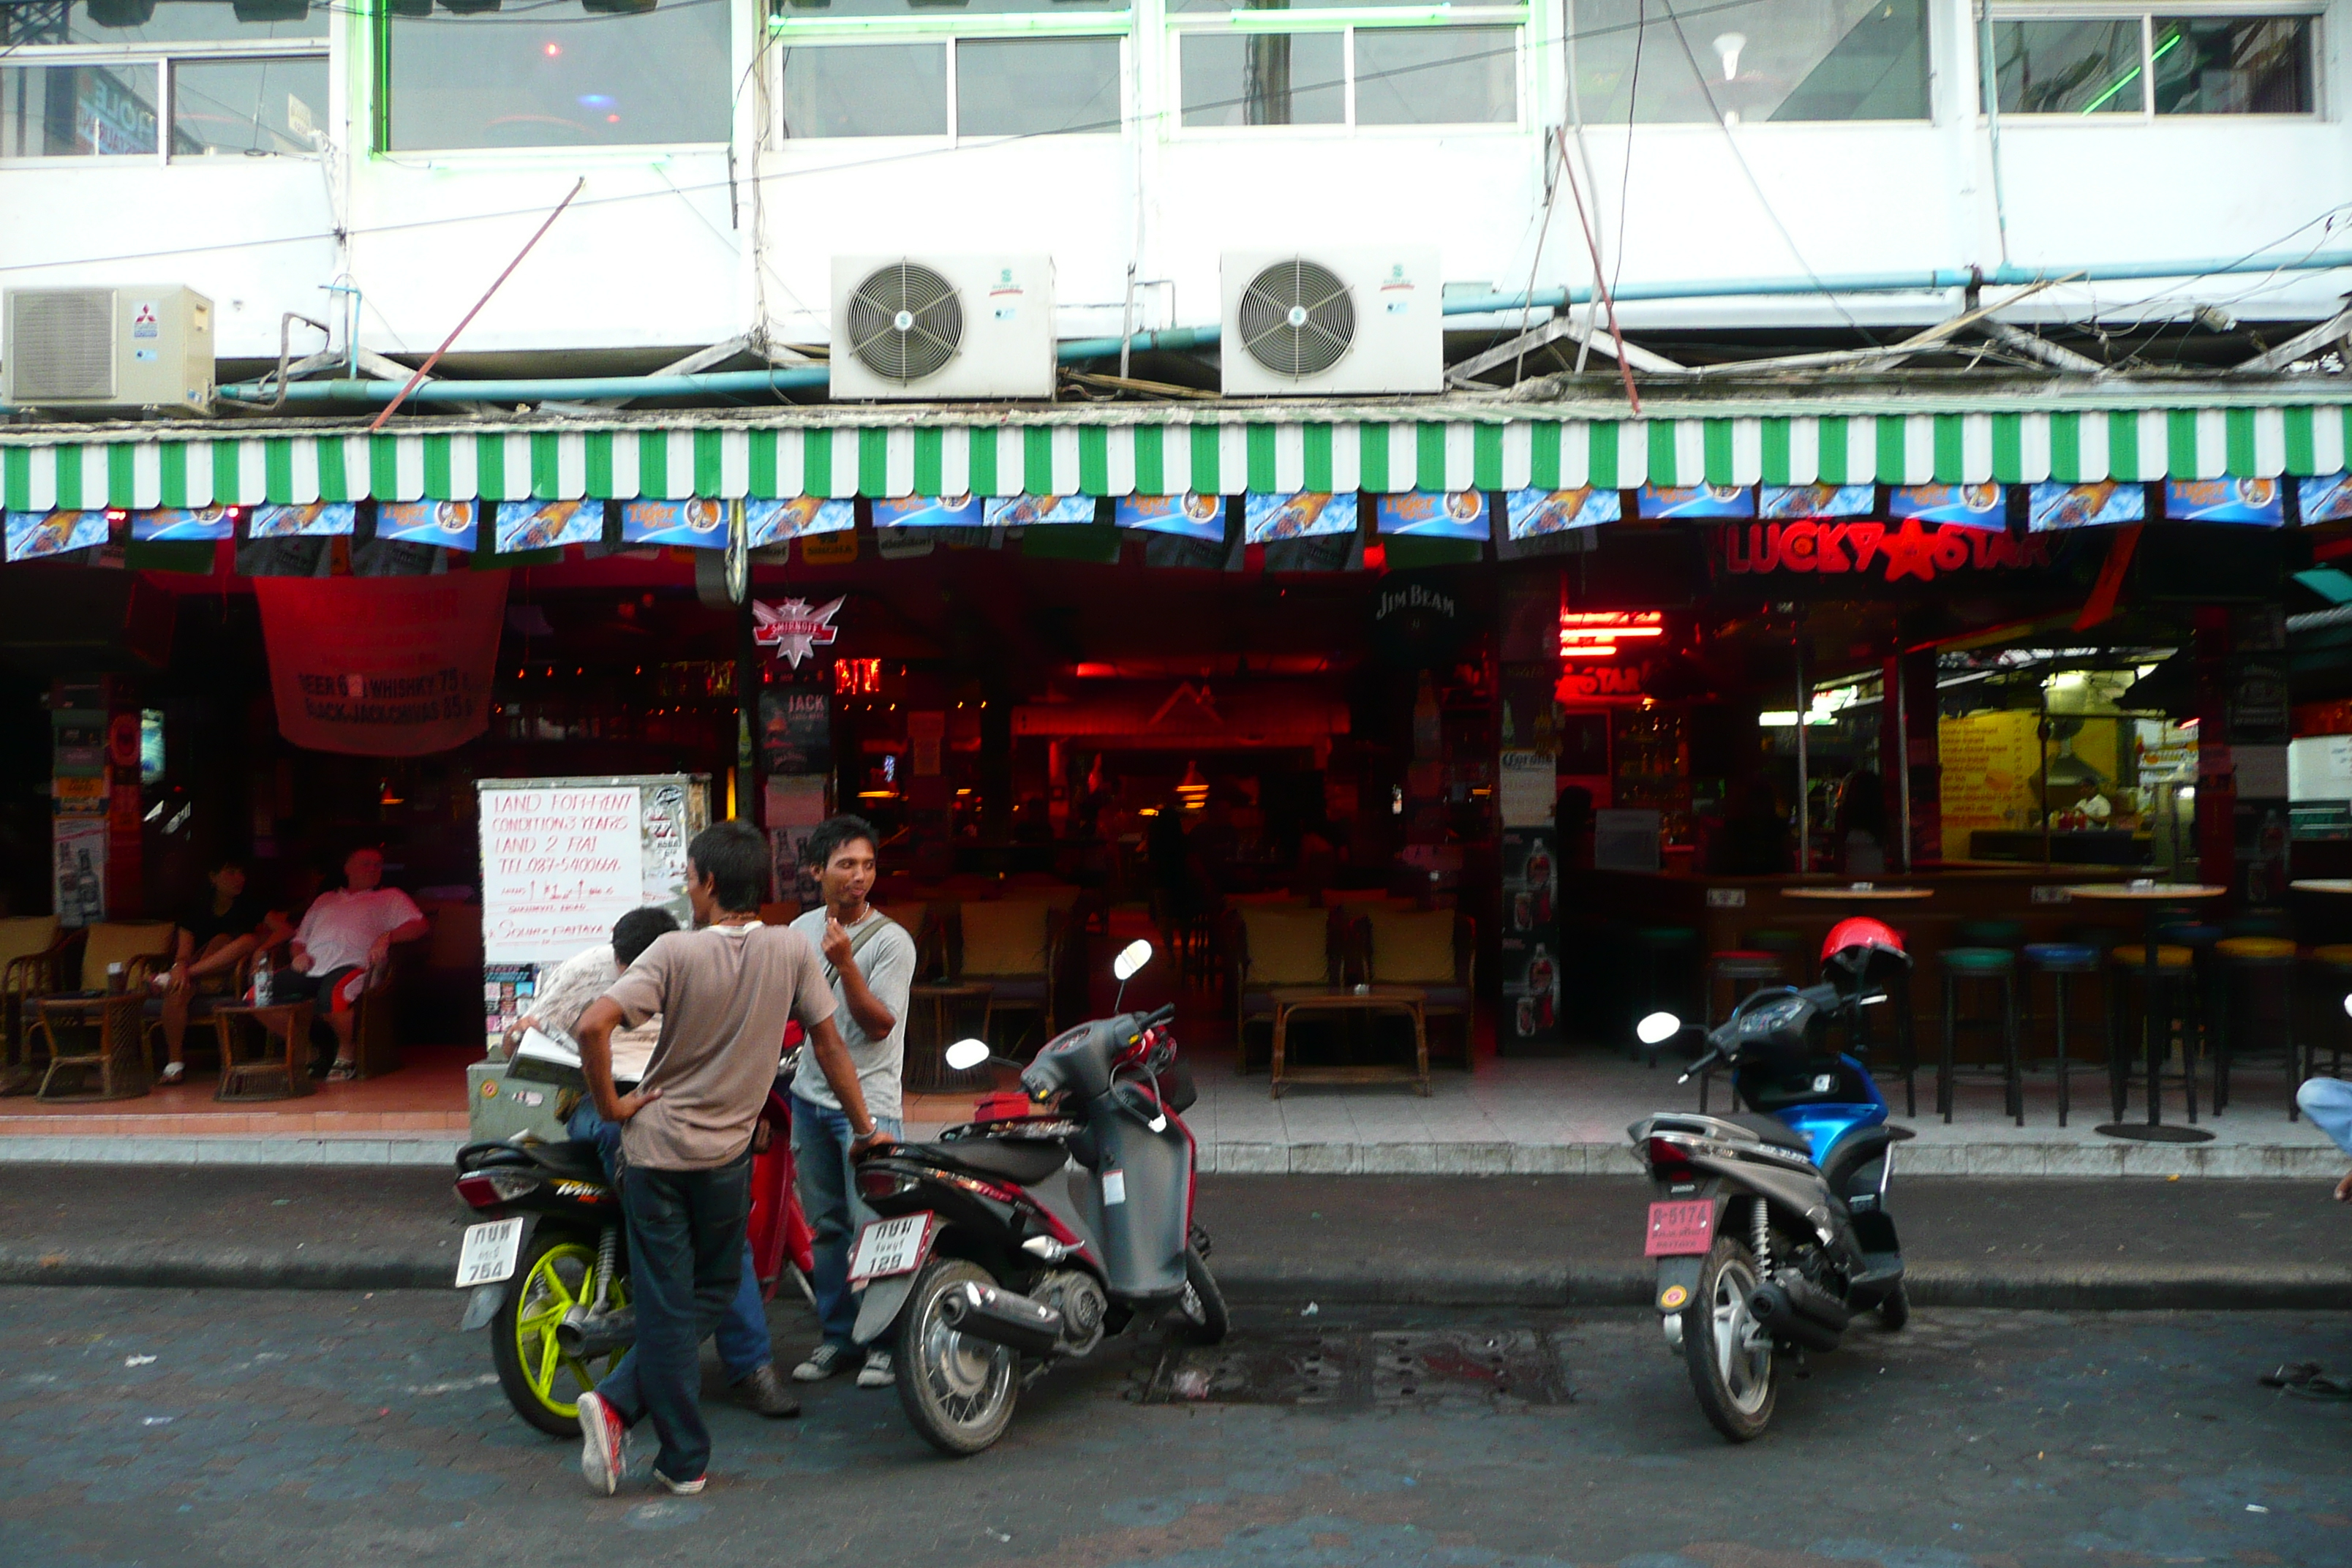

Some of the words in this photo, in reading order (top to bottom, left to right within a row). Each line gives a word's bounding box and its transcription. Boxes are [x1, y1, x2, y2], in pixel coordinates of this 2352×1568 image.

[627, 501, 678, 529] Tiger
[1727, 521, 1885, 573] LUCKY
[1934, 523, 2050, 571] STAR
[1376, 589, 1406, 621] JIM
[1410, 584, 1455, 618] BEAM
[771, 622, 819, 636] SMIRNOFF
[788, 695, 825, 714] JACK
[494, 794, 542, 813] LAND
[494, 837, 536, 854] LAND
[544, 835, 558, 853] 2
[467, 1260, 505, 1283] 754
